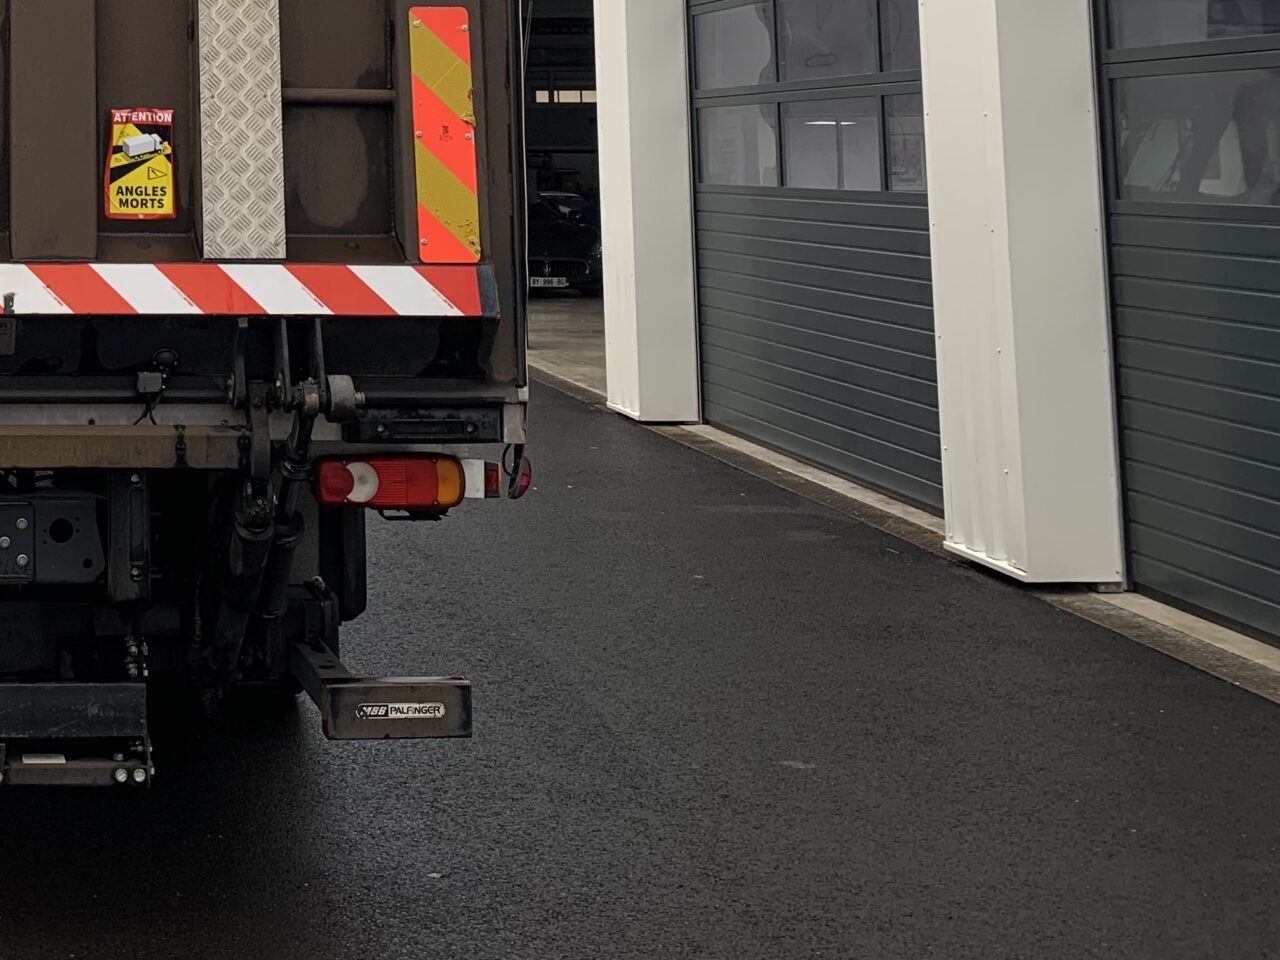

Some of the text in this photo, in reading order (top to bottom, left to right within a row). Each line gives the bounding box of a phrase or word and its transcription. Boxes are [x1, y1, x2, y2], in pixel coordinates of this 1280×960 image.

[113, 111, 172, 123] ATTENTION
[116, 185, 167, 197] ANGLES
[118, 198, 165, 209] MORTS
[390, 706, 441, 715] PALFINGER
